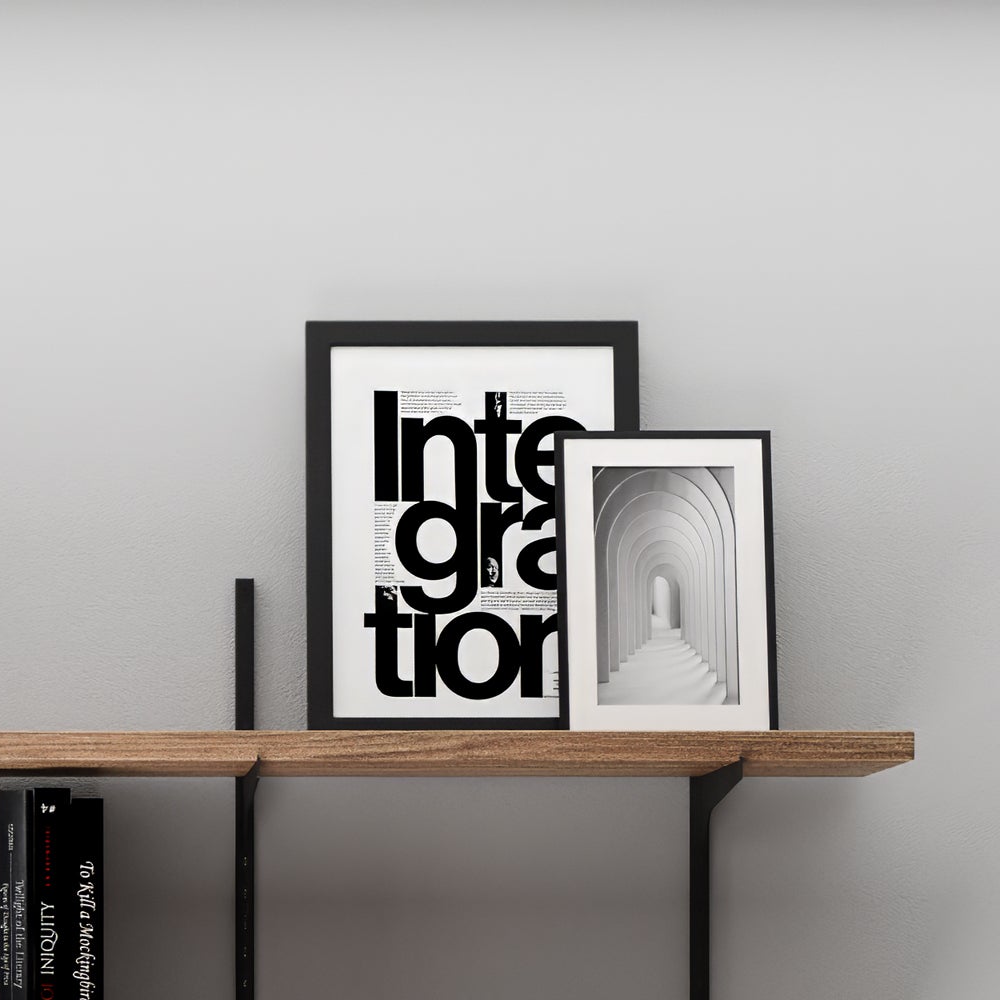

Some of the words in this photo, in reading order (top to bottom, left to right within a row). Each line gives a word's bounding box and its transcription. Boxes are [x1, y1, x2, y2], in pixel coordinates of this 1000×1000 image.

[79, 861, 94, 878] To
[14, 880, 25, 919] Twilight
[77, 881, 95, 907] Kill
[80, 911, 90, 919] a
[16, 934, 24, 948] the
[40, 901, 59, 975] INIQUITY
